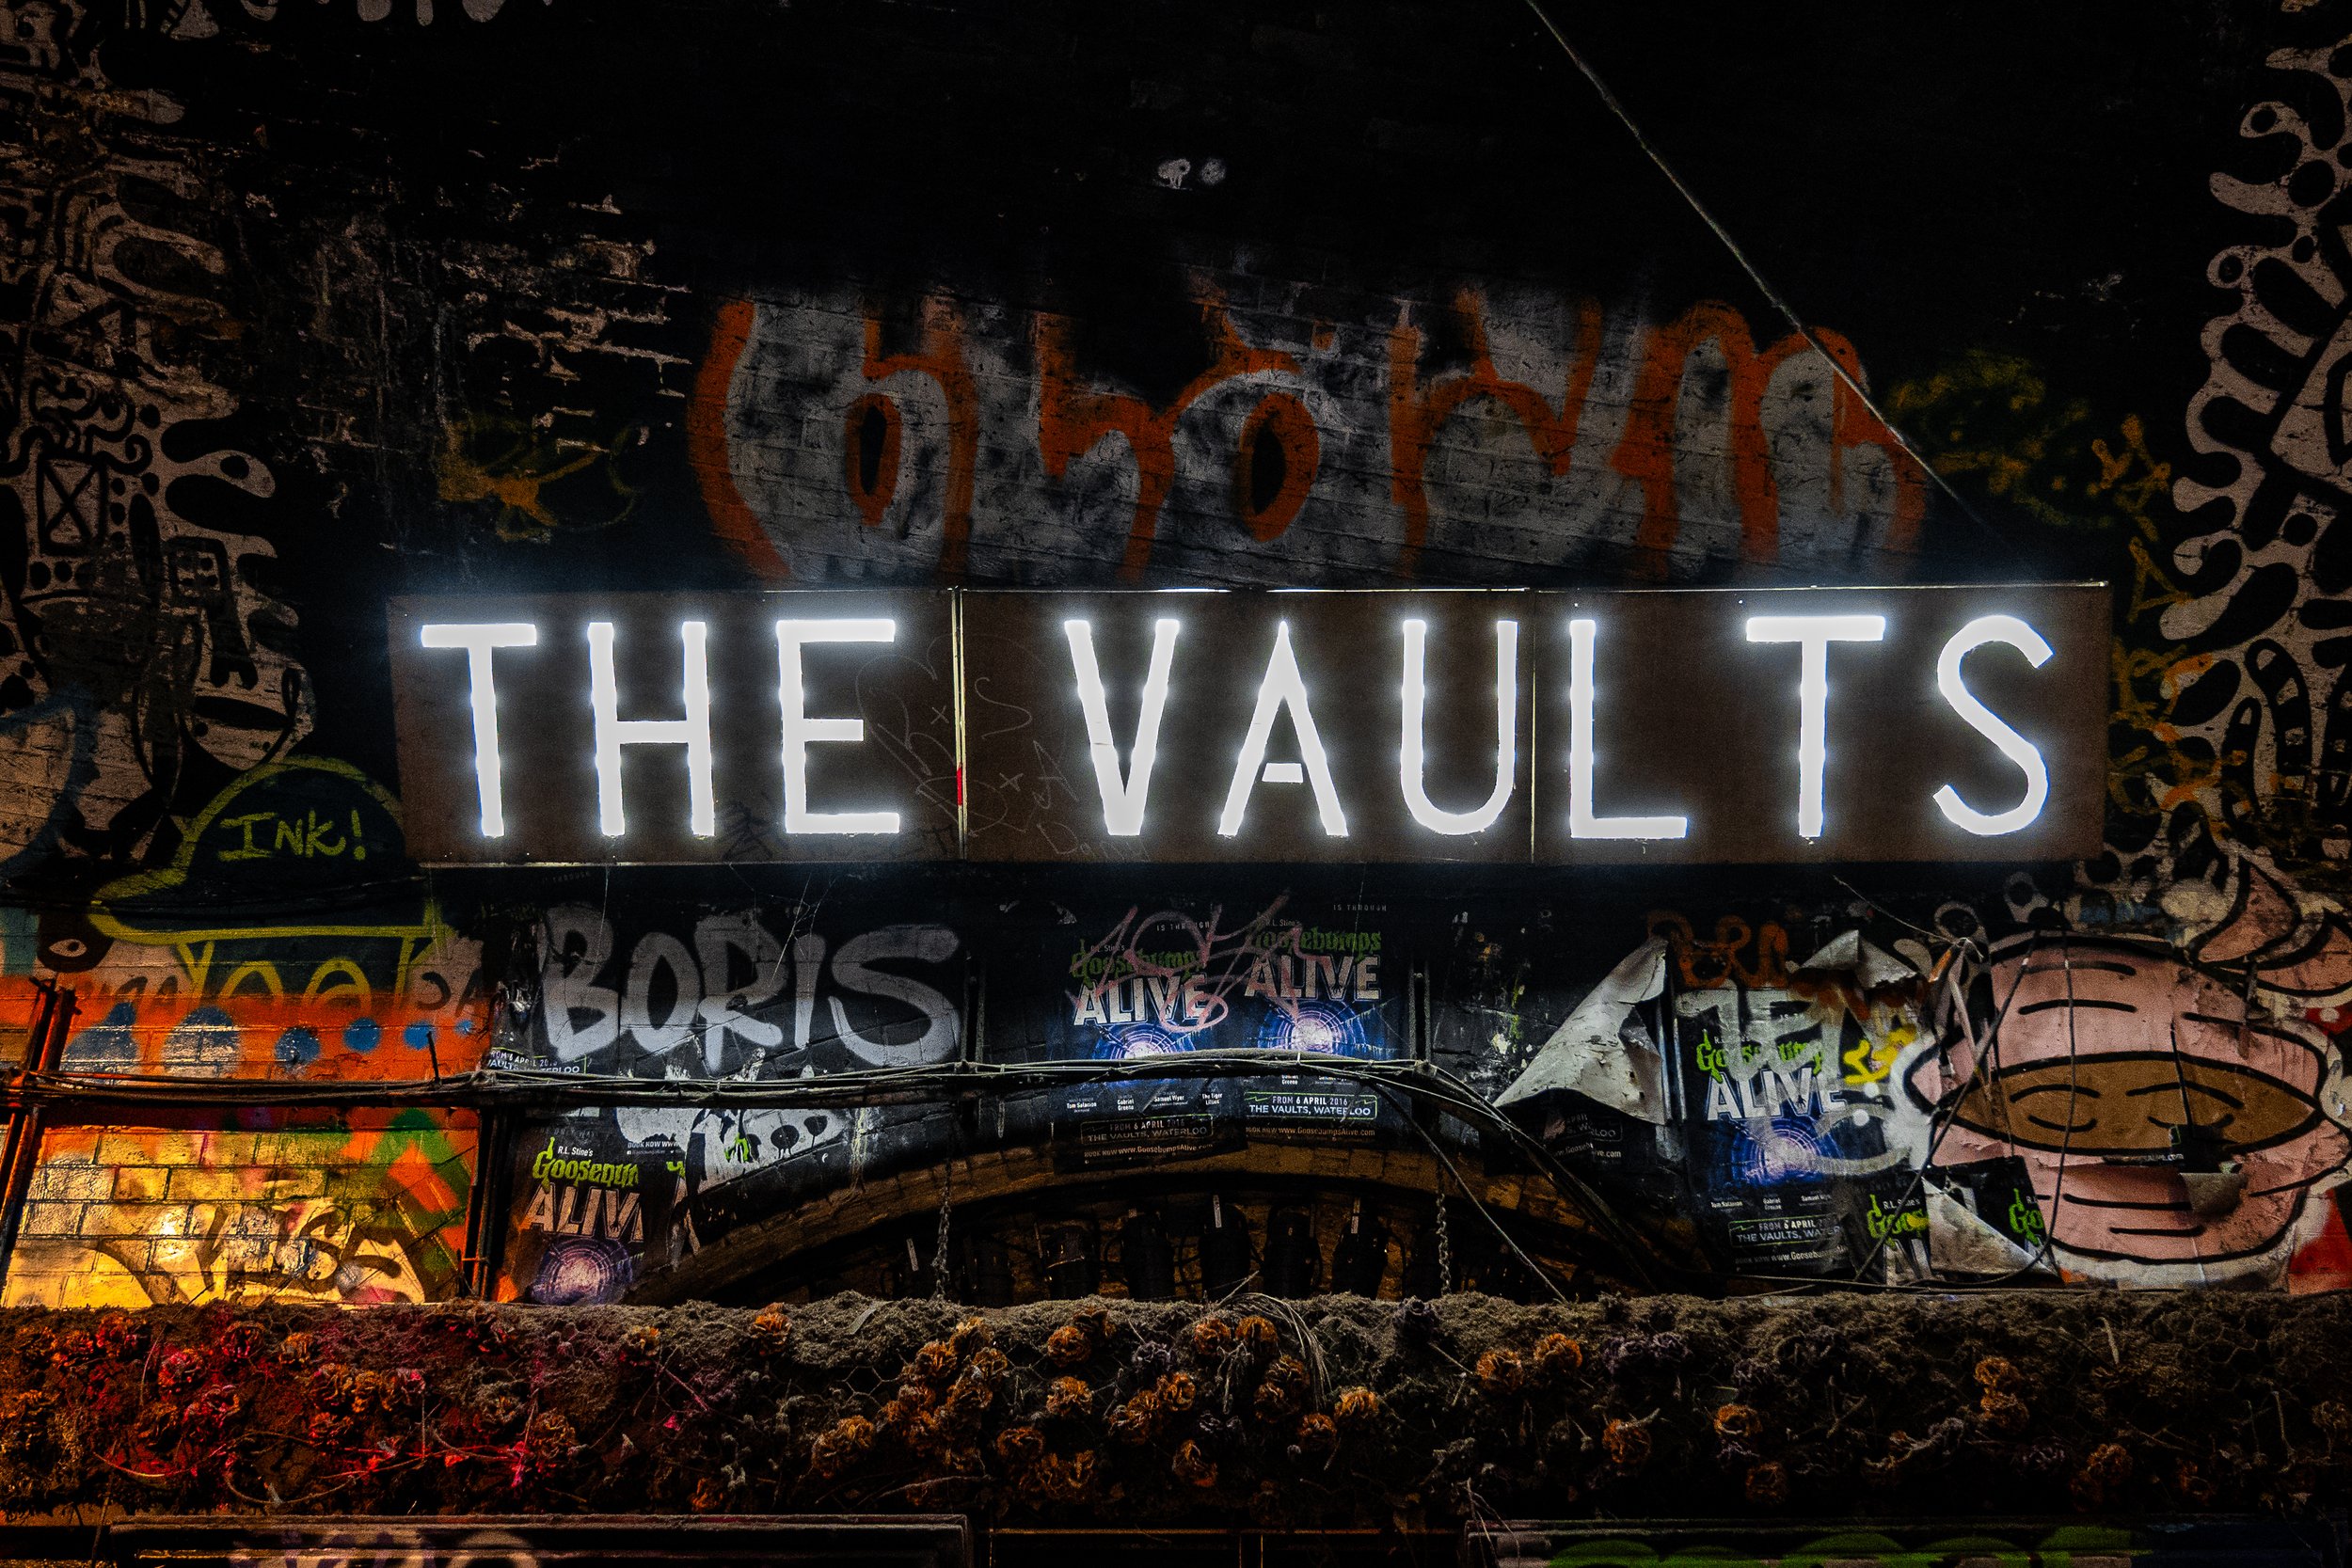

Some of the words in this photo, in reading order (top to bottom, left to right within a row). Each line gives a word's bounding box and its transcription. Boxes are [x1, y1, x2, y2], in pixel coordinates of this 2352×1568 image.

[419, 617, 901, 839] THE
[1062, 614, 2055, 839] VAULTS
[1244, 954, 1381, 1000] ALIVE
[538, 901, 961, 1076] BORIS
[1073, 973, 1211, 1026] ALIVE
[1272, 1096, 1294, 1104] FROM
[1295, 1096, 1301, 1104] 6
[1303, 1096, 1327, 1105] APRIL
[1329, 1097, 1348, 1105] 2016
[1707, 1067, 1847, 1120] ALIVE
[1248, 1104, 1269, 1114] THE
[1271, 1104, 1311, 1116] VAULTS,
[1109, 1122, 1132, 1132] FROM
[1140, 1119, 1165, 1130] APRIL
[1088, 1132, 1107, 1142] THE
[1152, 1126, 1208, 1137] WATERLOO
[557, 1145, 570, 1155] R.L.
[571, 1147, 594, 1157] Stine's
[1758, 1222, 1781, 1231] FROM
[1790, 1219, 1817, 1228] APRIL
[1736, 1233, 1757, 1243] THE
[1759, 1230, 1803, 1242] VAULTS,
